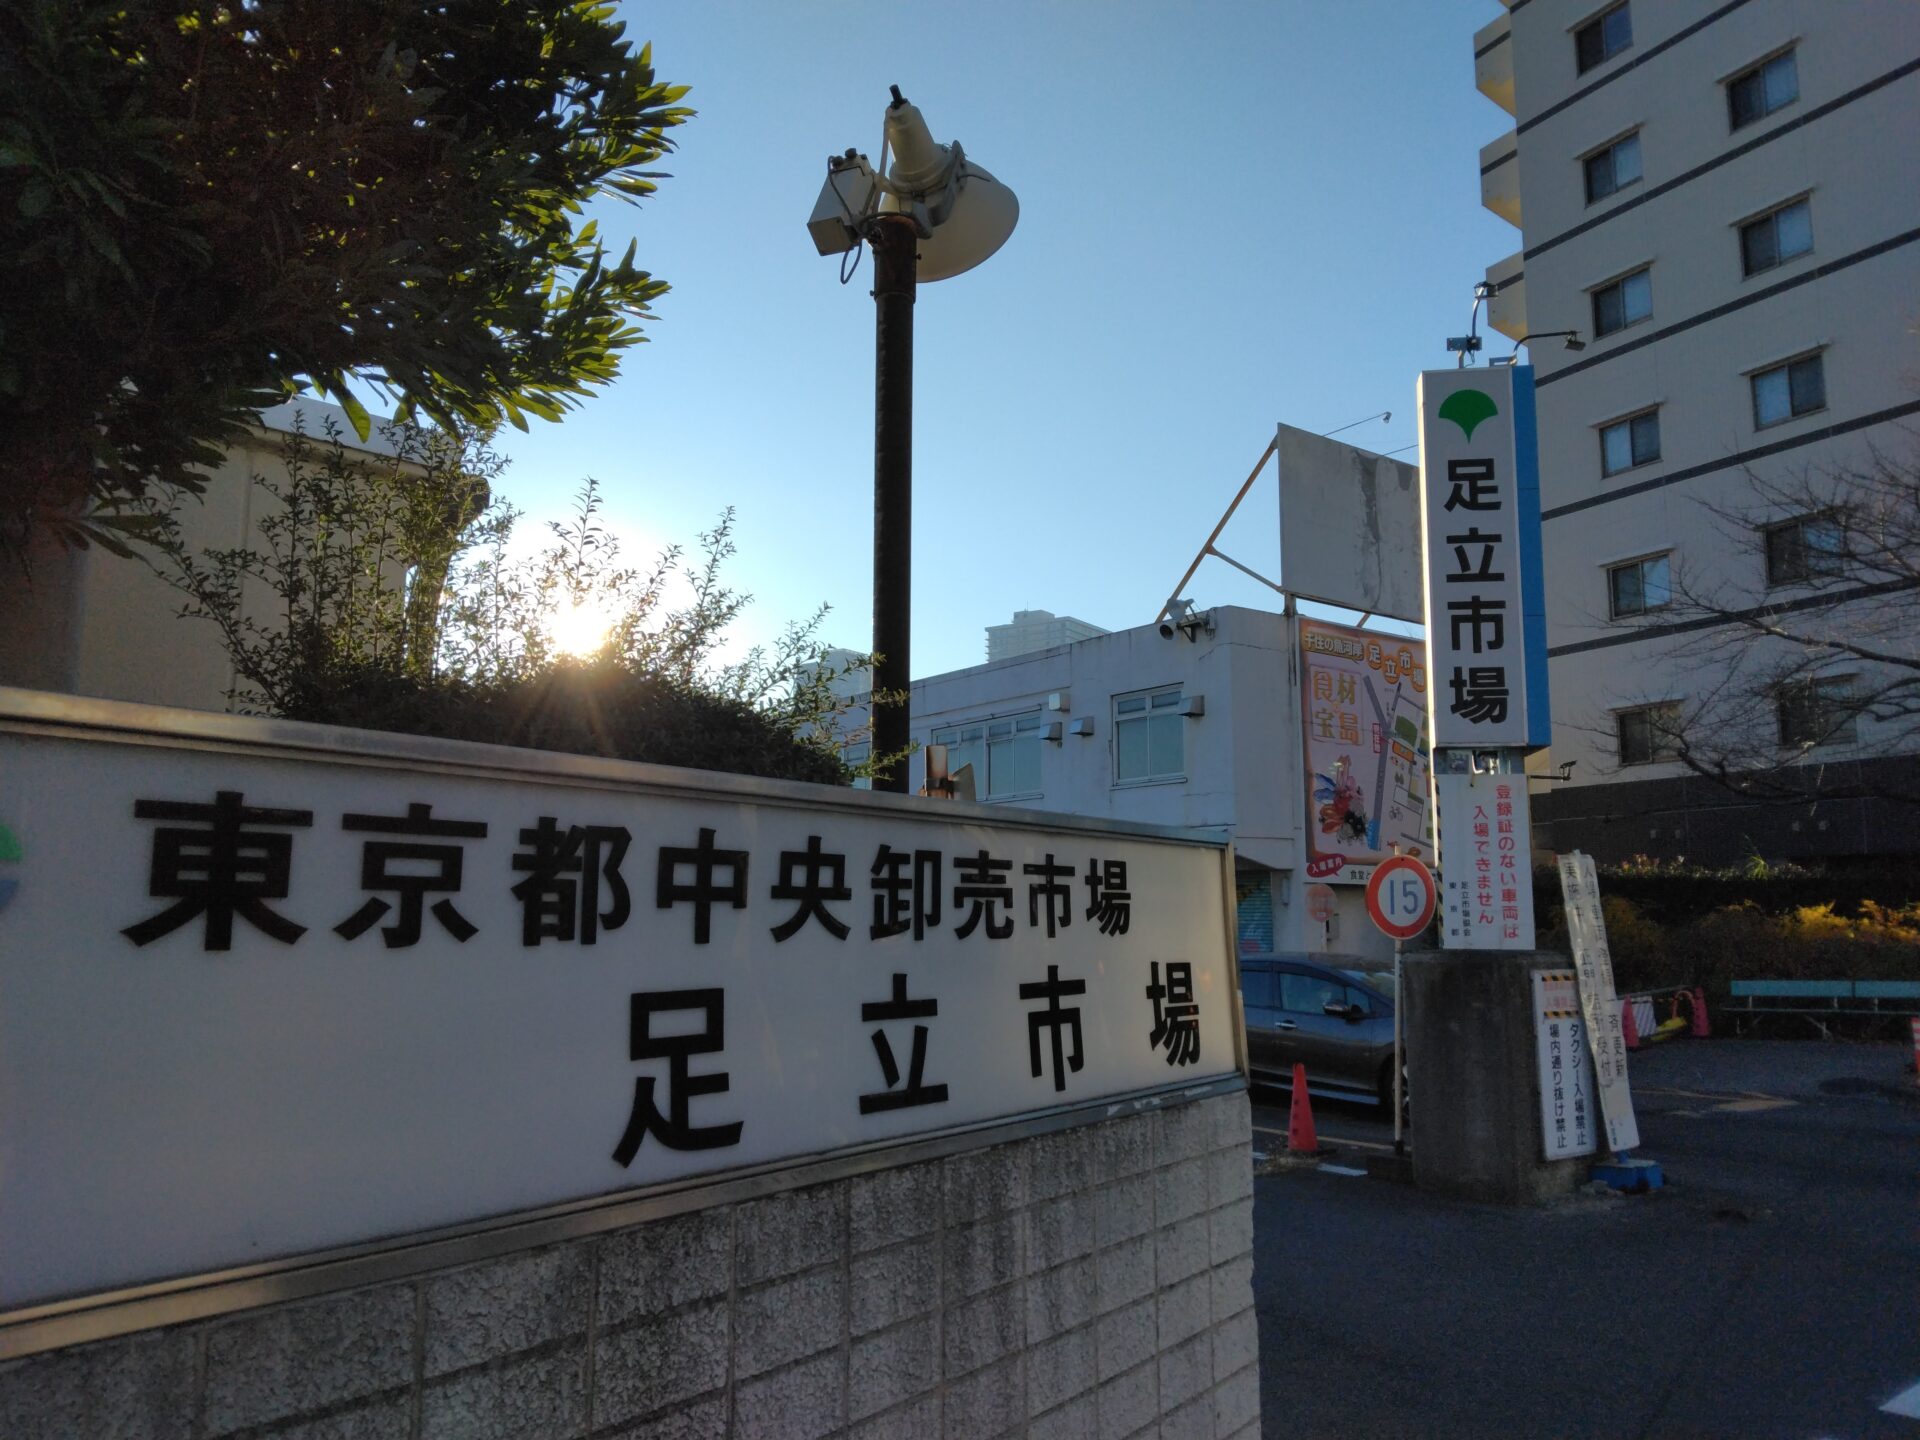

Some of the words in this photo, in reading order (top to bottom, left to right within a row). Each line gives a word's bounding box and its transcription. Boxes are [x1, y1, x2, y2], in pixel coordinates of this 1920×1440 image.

[1444, 458, 1509, 724] 足立市場
[119, 791, 1131, 950] 東京都中央卸売市場
[1390, 879, 1418, 915] 15
[1473, 805, 1493, 924] 入場できません
[1496, 784, 1519, 939] 登録証のない車両は
[612, 961, 1200, 1168] 足立市場
[1550, 1024, 1567, 1149] 場内通り抜け禁止
[1570, 1024, 1586, 1146] タクシー入場禁止
